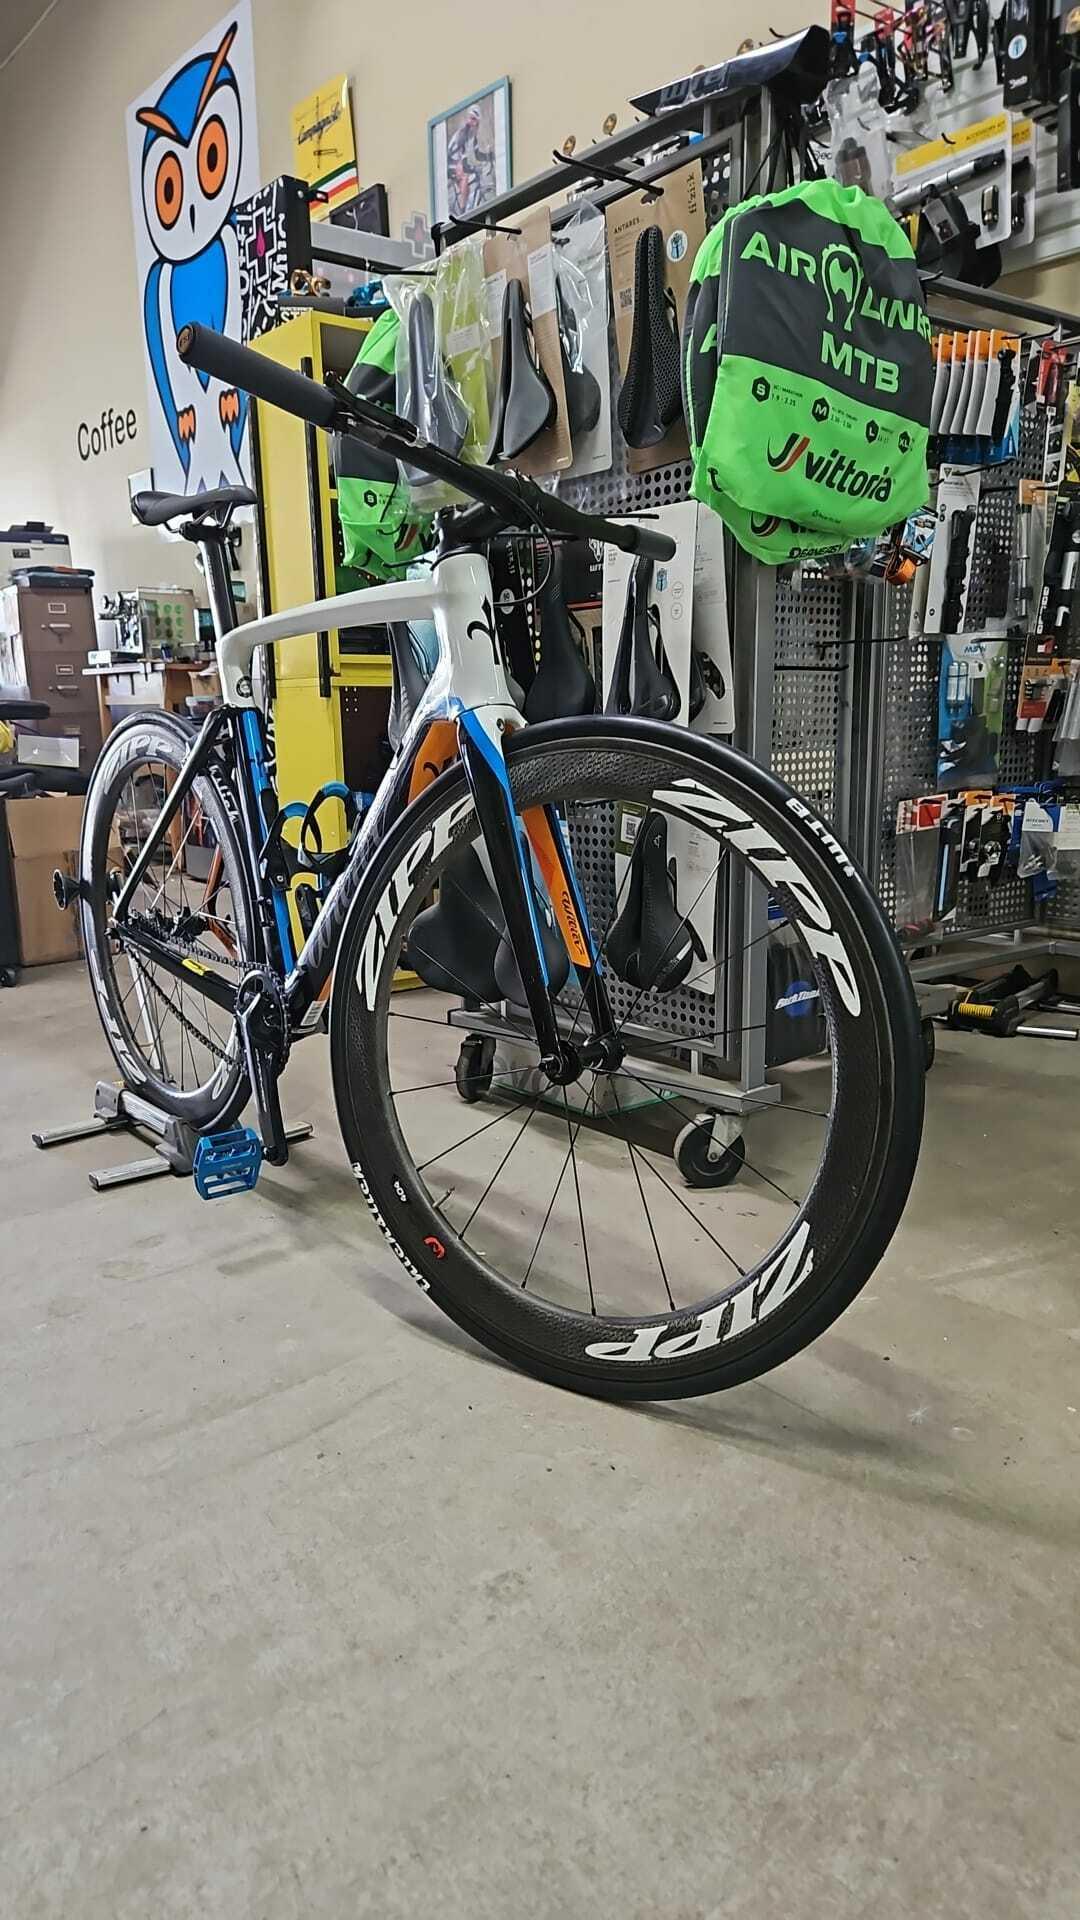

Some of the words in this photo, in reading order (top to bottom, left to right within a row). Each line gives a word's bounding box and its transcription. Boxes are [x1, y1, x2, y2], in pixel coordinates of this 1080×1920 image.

[740, 231, 817, 284] AIR
[821, 330, 899, 393] MTB
[77, 407, 137, 461] Coffee
[804, 449, 893, 502] vittoria
[355, 793, 476, 1012] ZIPP
[652, 778, 862, 1016] ZIPP
[392, 1179, 410, 1204] 404
[585, 1220, 814, 1361] ZIPP
